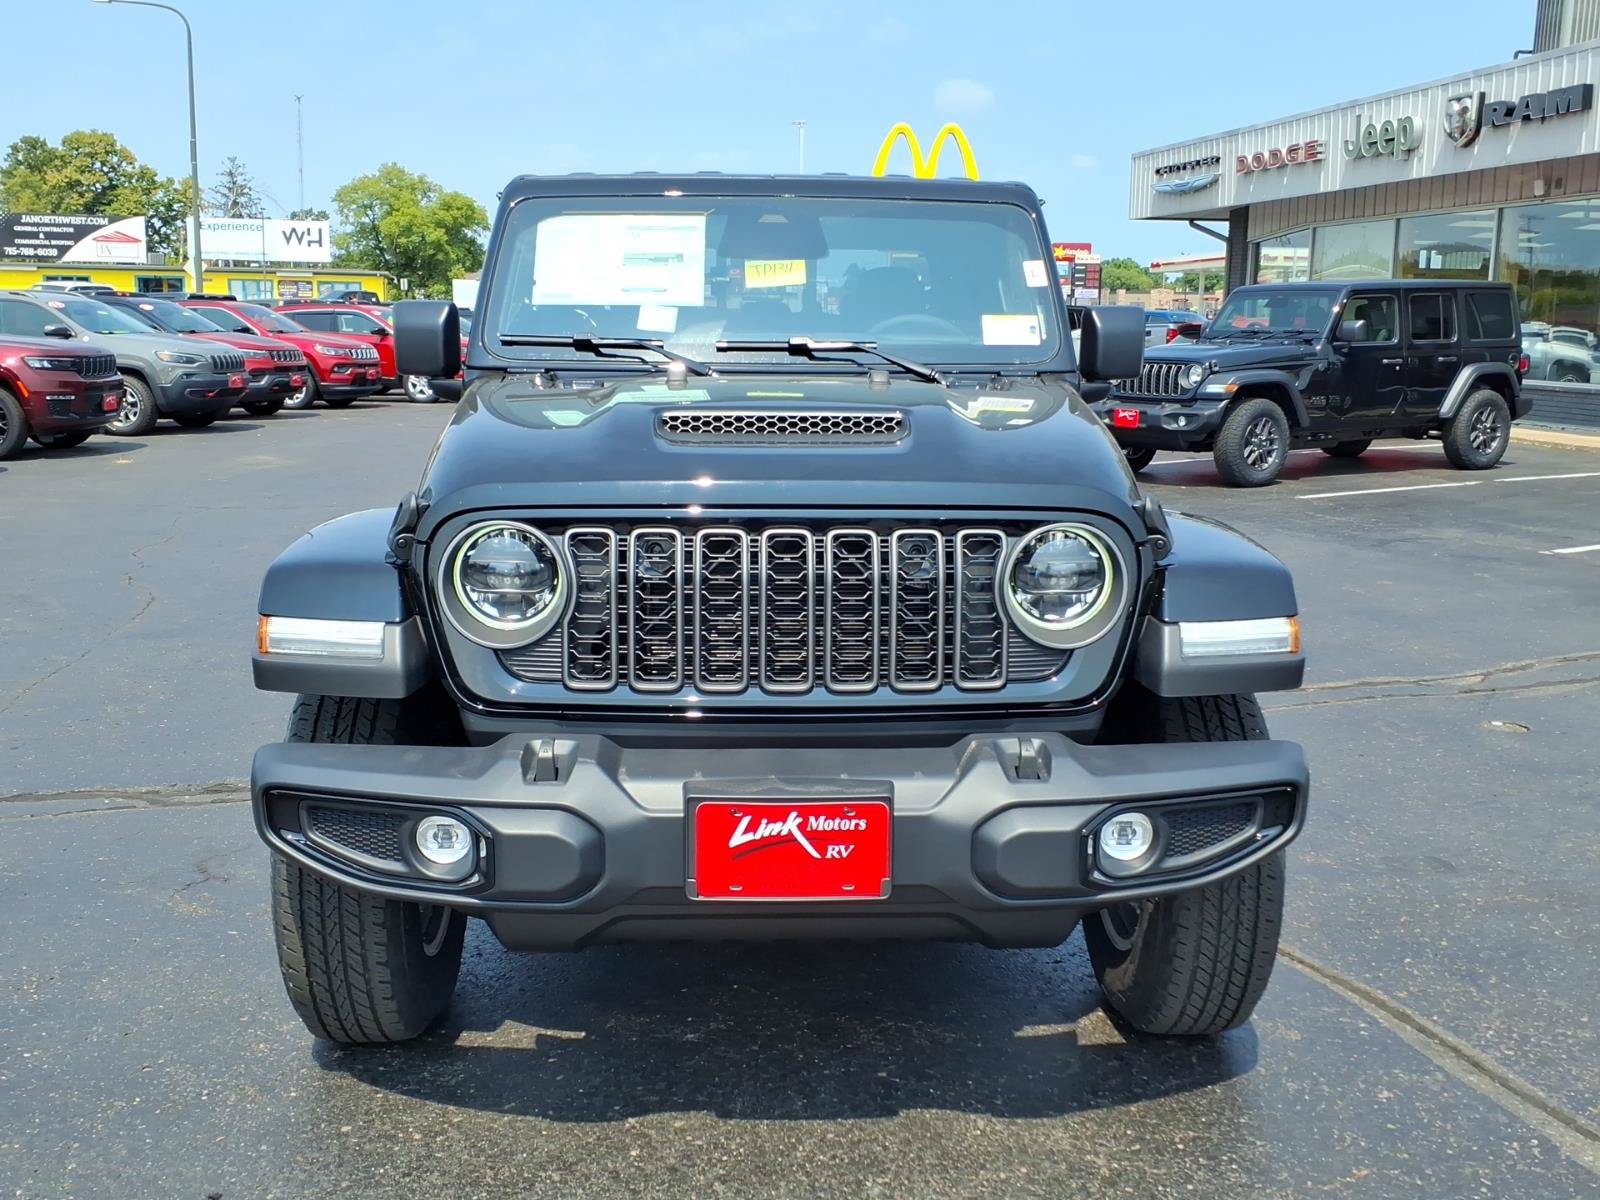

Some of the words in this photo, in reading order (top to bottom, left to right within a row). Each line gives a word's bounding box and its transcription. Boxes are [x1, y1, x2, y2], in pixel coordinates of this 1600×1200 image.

[1484, 83, 1593, 127] RAM
[1344, 113, 1422, 160] Jeep
[1236, 139, 1325, 174] DODGE
[20, 214, 109, 226] JANORTHWEST.COM
[200, 221, 264, 232] Experience
[3, 246, 58, 257] 715-768-6039
[728, 811, 823, 859] Link
[806, 815, 867, 831] Motors
[825, 844, 855, 859] RV
